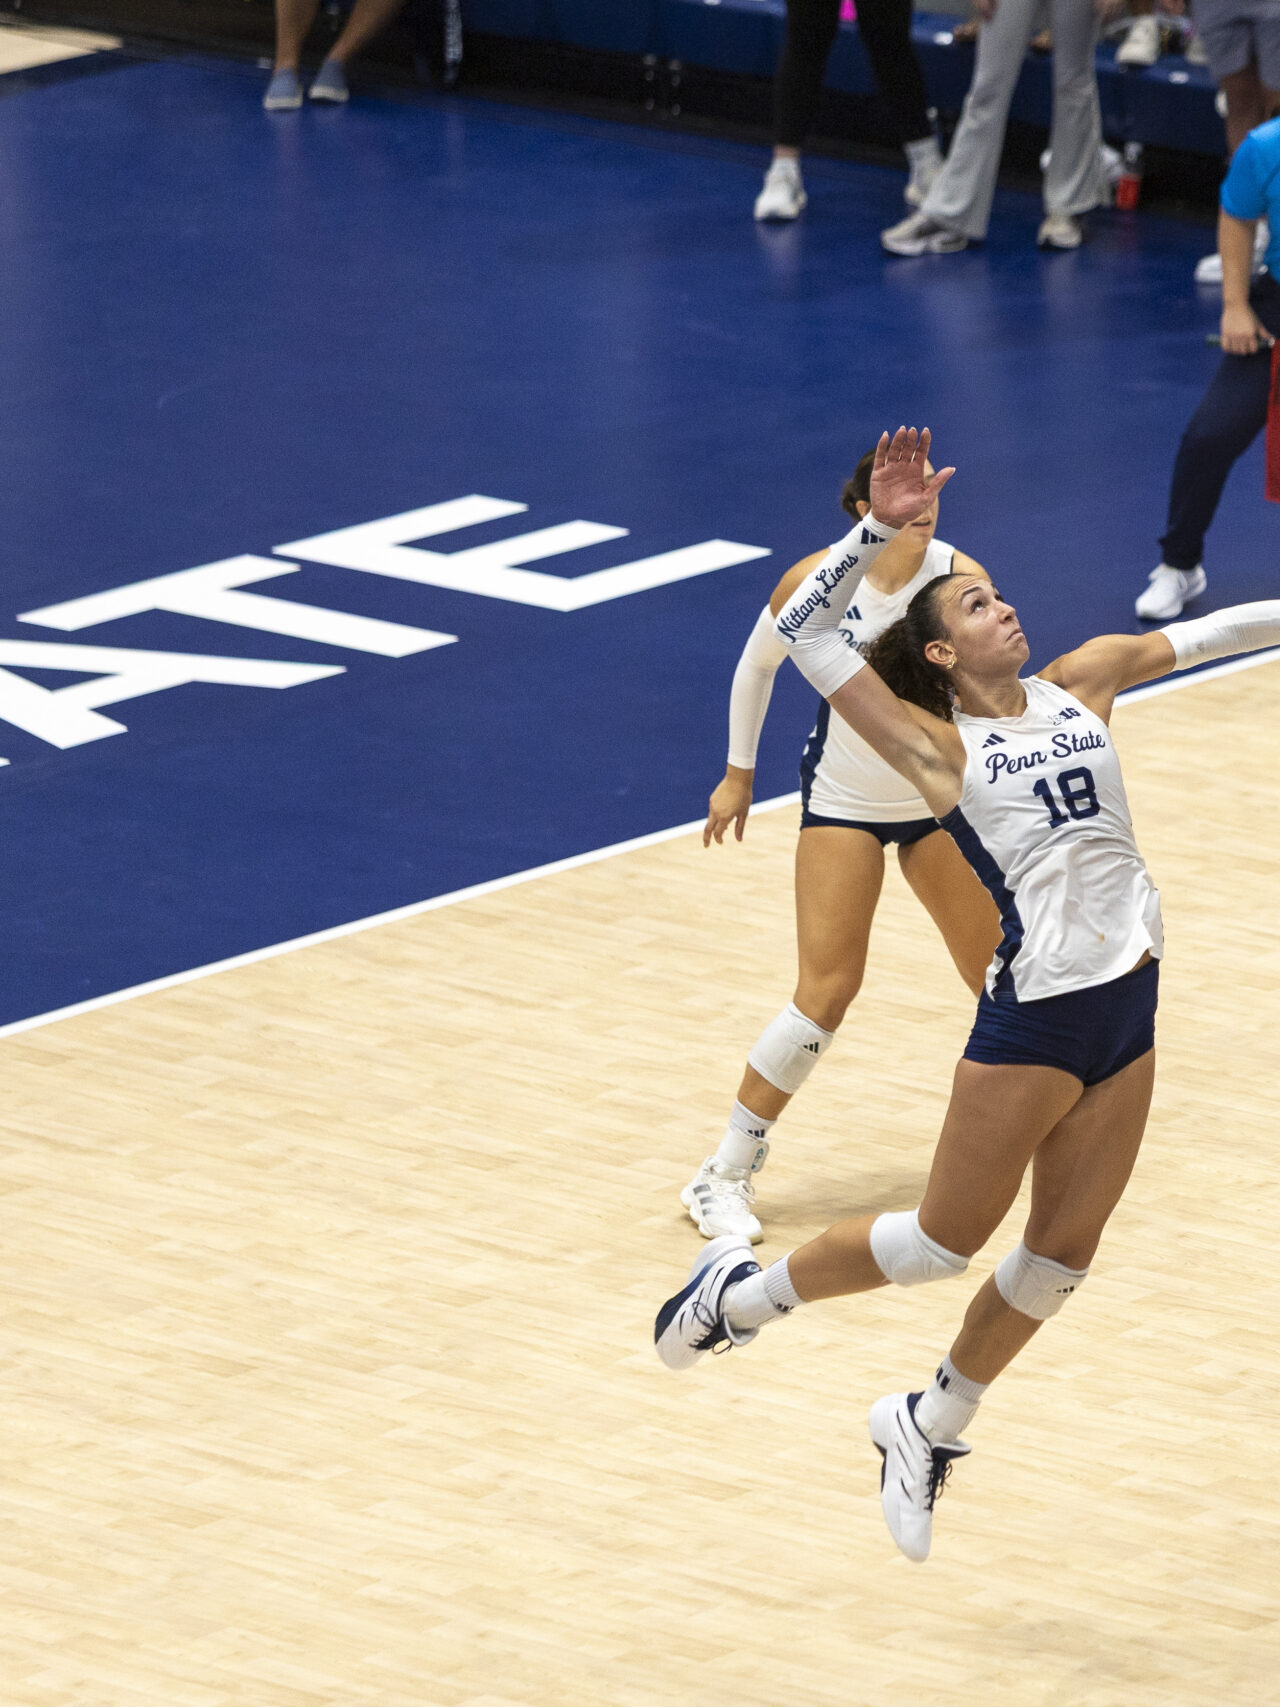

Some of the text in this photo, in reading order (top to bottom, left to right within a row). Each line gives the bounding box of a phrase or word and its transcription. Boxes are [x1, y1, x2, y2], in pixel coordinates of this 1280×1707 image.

[777, 553, 858, 644] Nittany Lions
[985, 730, 1105, 784] Penn State
[1033, 766, 1100, 829] 18
